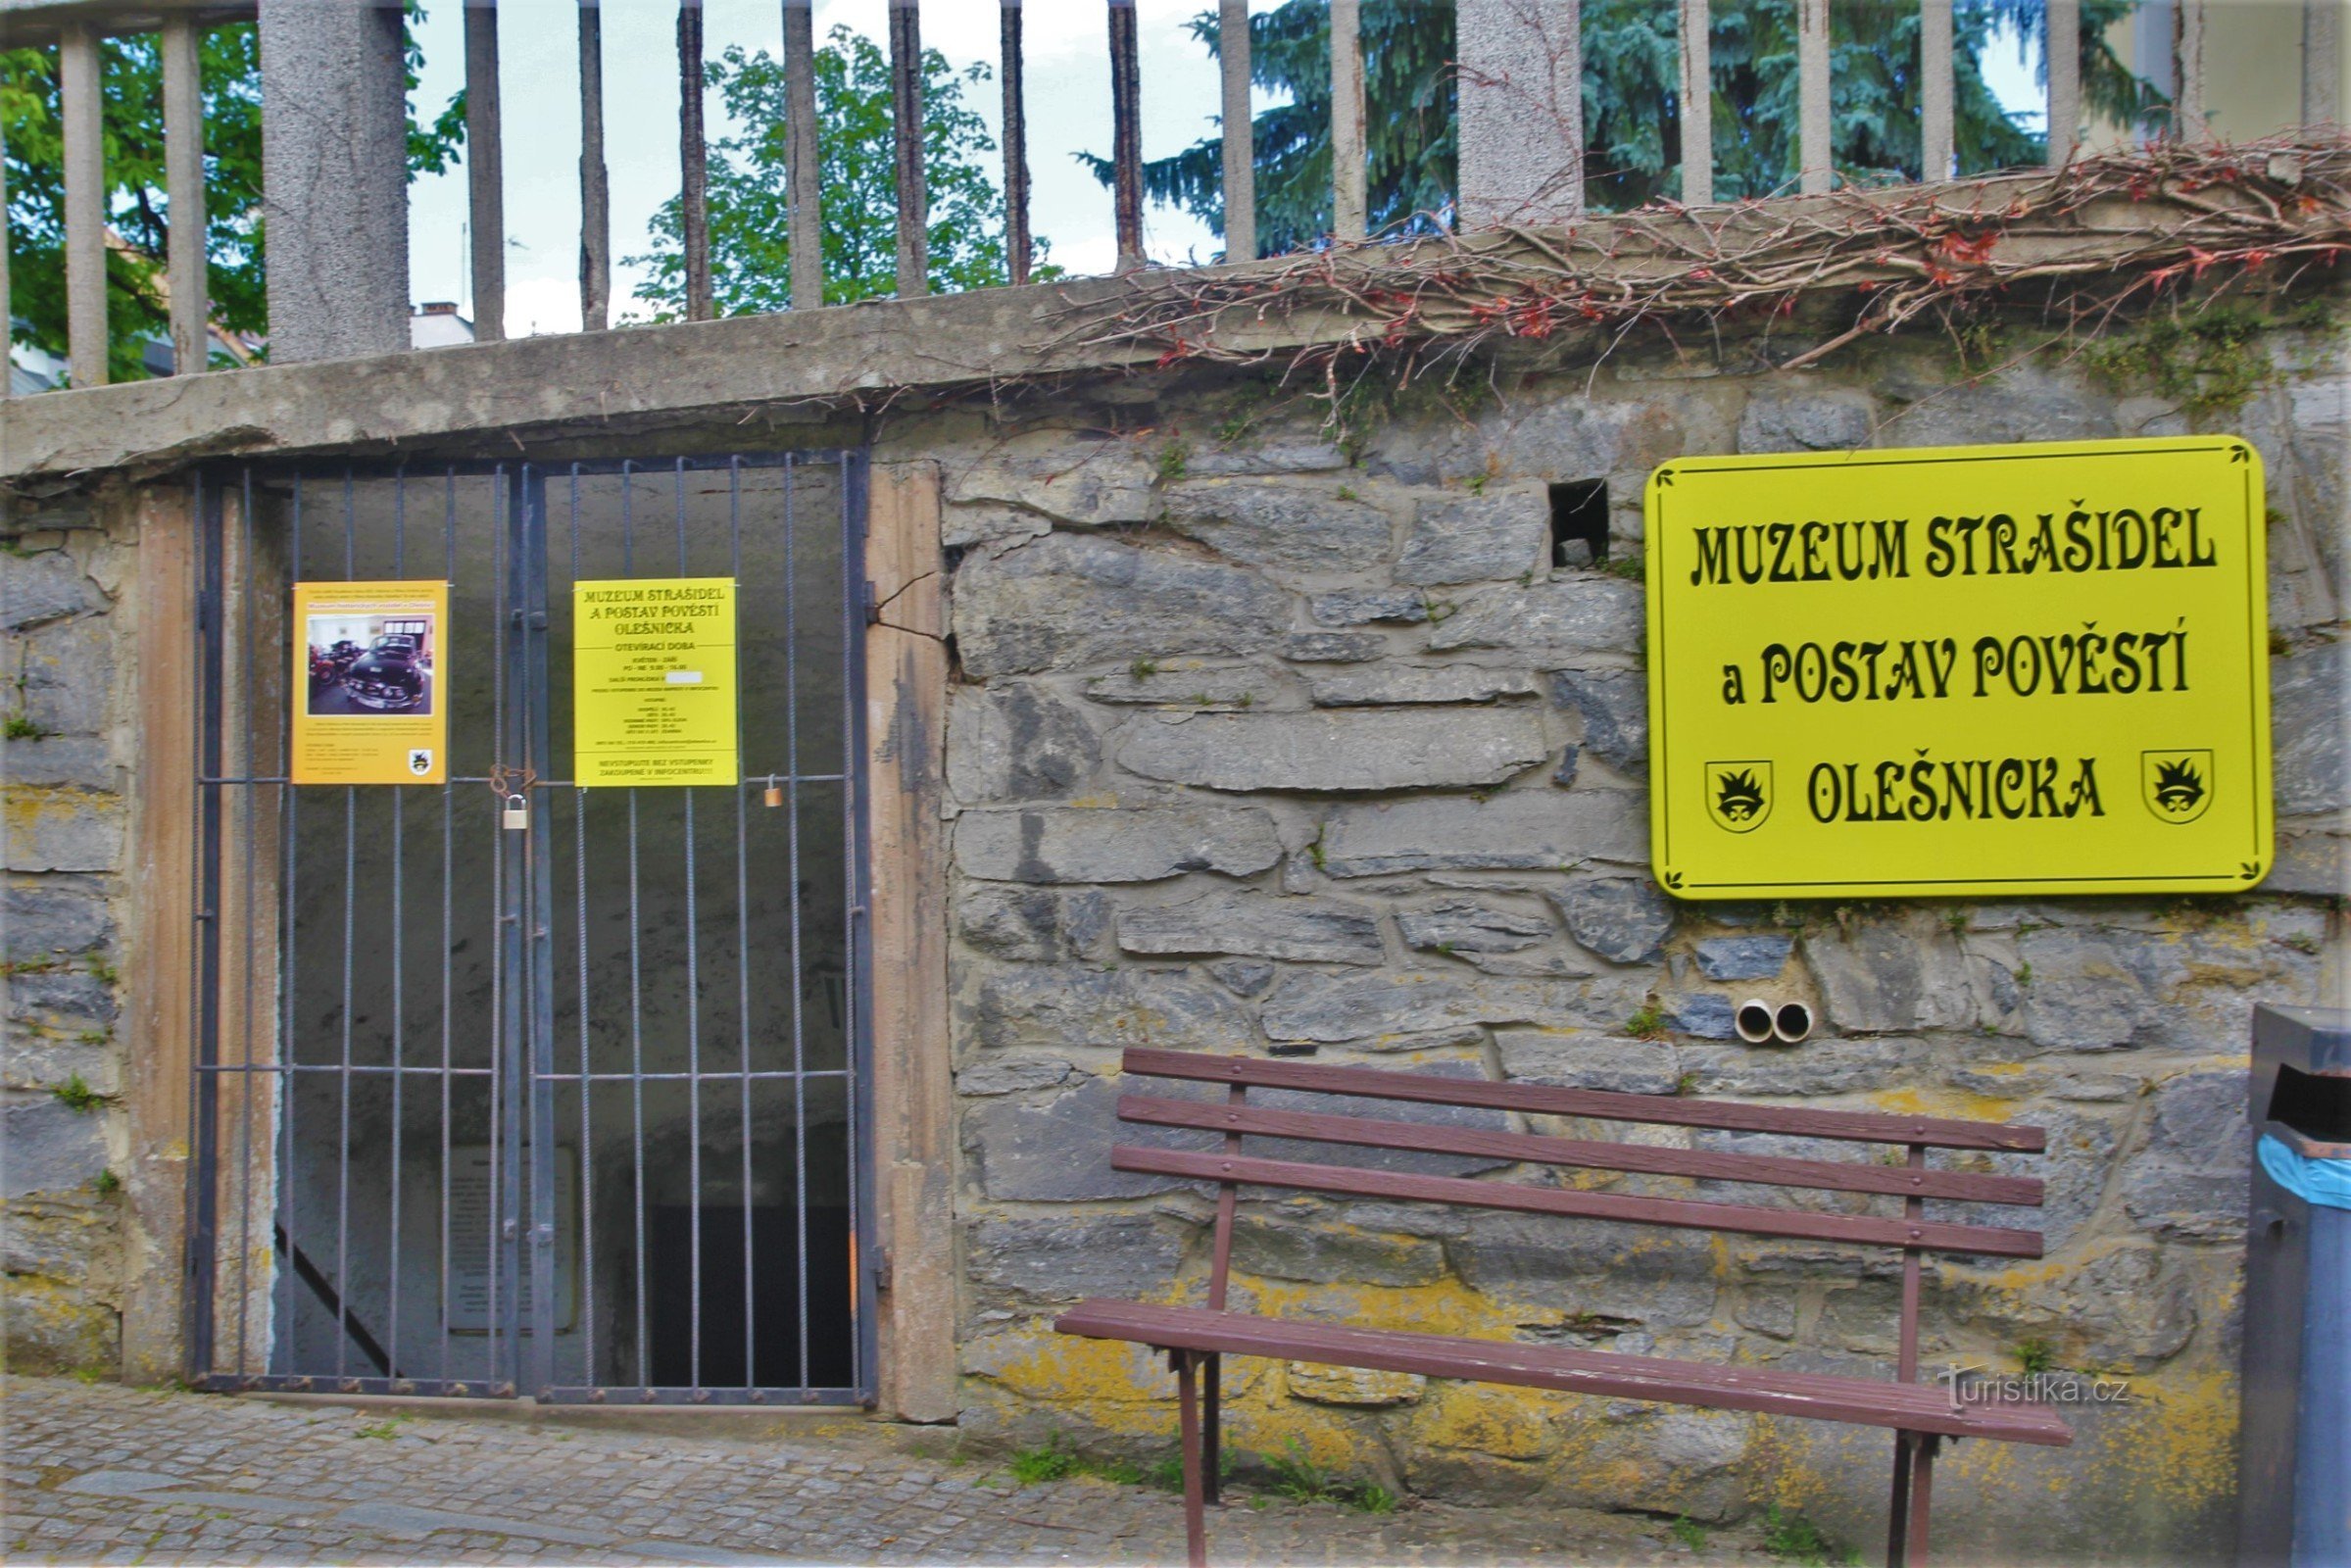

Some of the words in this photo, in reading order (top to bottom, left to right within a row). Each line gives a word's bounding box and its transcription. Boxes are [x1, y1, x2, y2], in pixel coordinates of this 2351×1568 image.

[1690, 519, 1909, 586] MUZEUM
[1926, 499, 2217, 577] STRAŠIDEL
[584, 590, 644, 603] MUZEUM
[648, 587, 724, 601] STRAŠIDEL
[589, 608, 601, 619] A
[605, 606, 658, 618] POSTAV
[661, 602, 720, 617] POVĚSTÍ
[614, 620, 695, 635] OLEŠNICKA
[667, 642, 696, 651] DOBA
[1723, 661, 1745, 705] a
[1761, 638, 1958, 704] POSTAV
[1973, 616, 2189, 699] POVĚSTÍ
[1807, 749, 2105, 823] OLEŠNICKA
